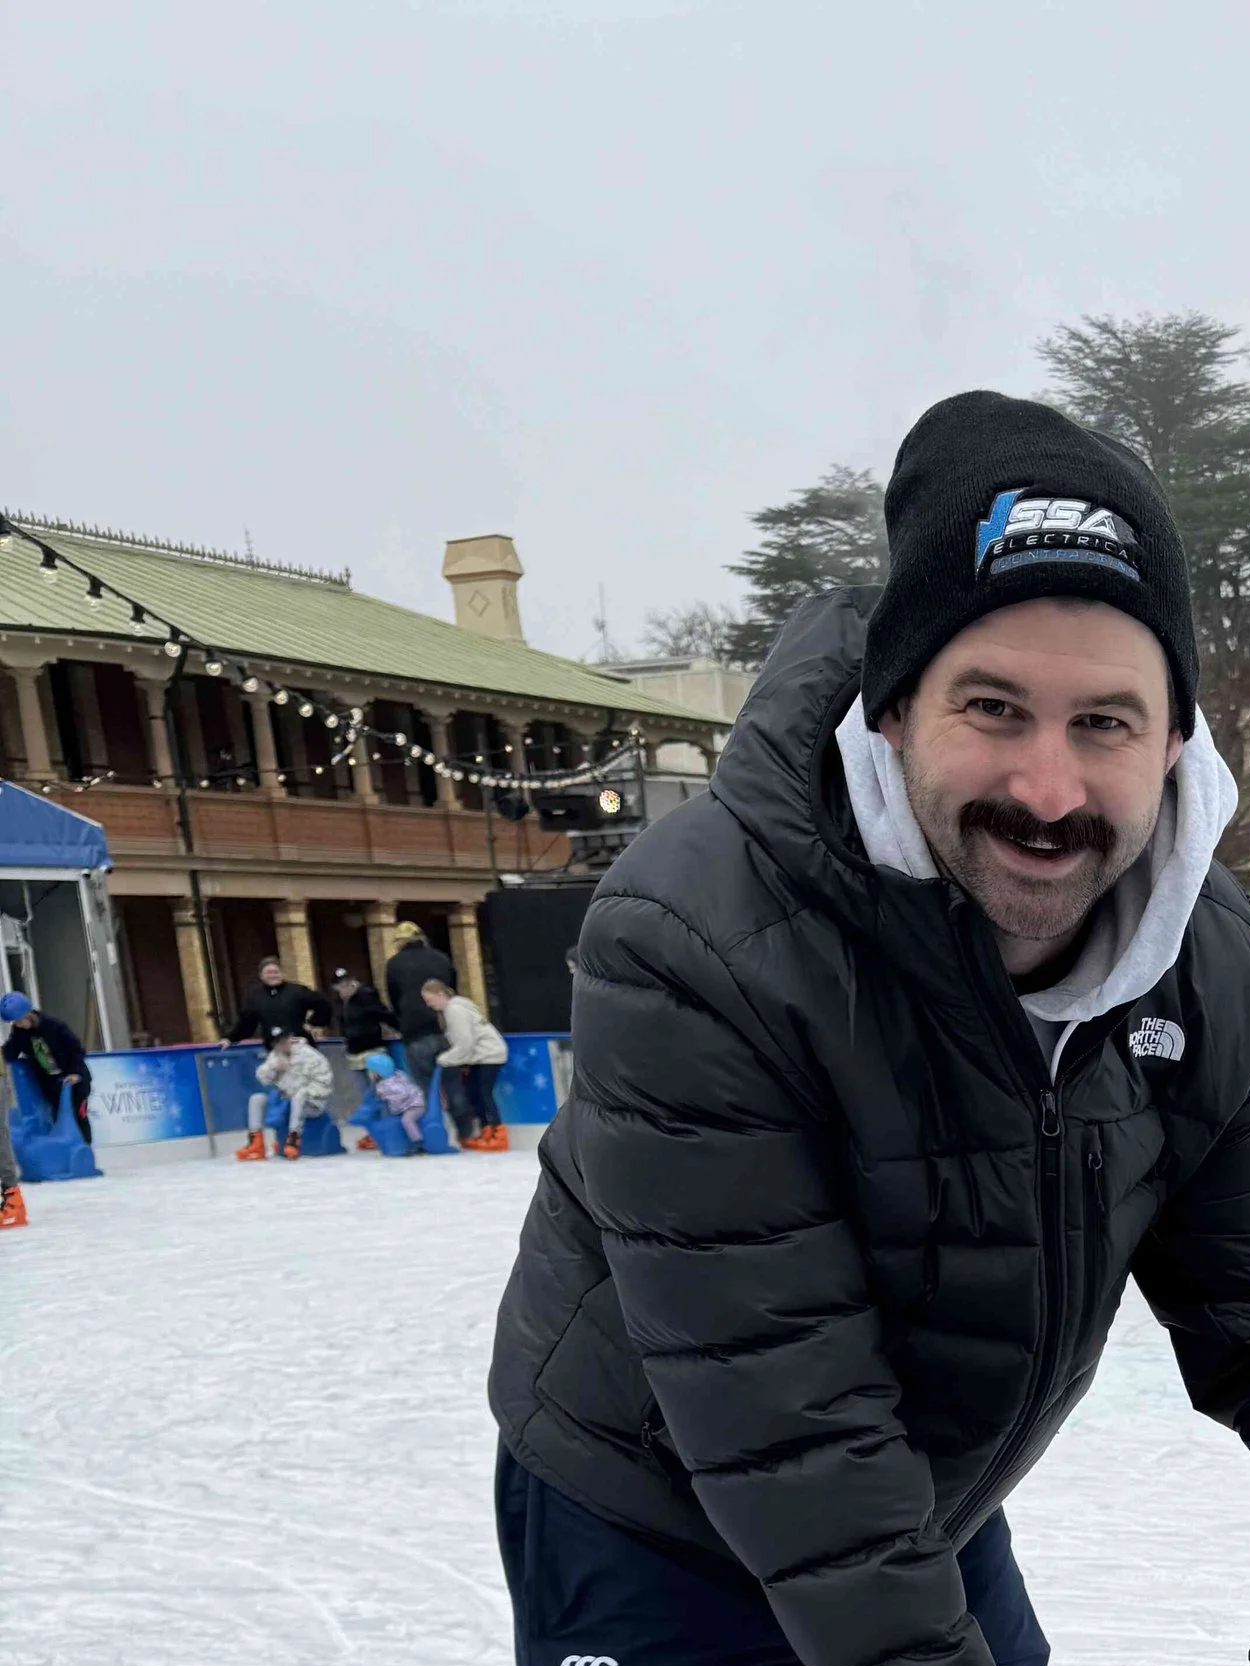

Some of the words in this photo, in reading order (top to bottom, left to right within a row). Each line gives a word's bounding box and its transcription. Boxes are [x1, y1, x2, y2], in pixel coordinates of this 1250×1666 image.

[1004, 499, 1119, 542] SSA
[1141, 1017, 1166, 1031] THE
[1132, 1043, 1158, 1057] FACE
